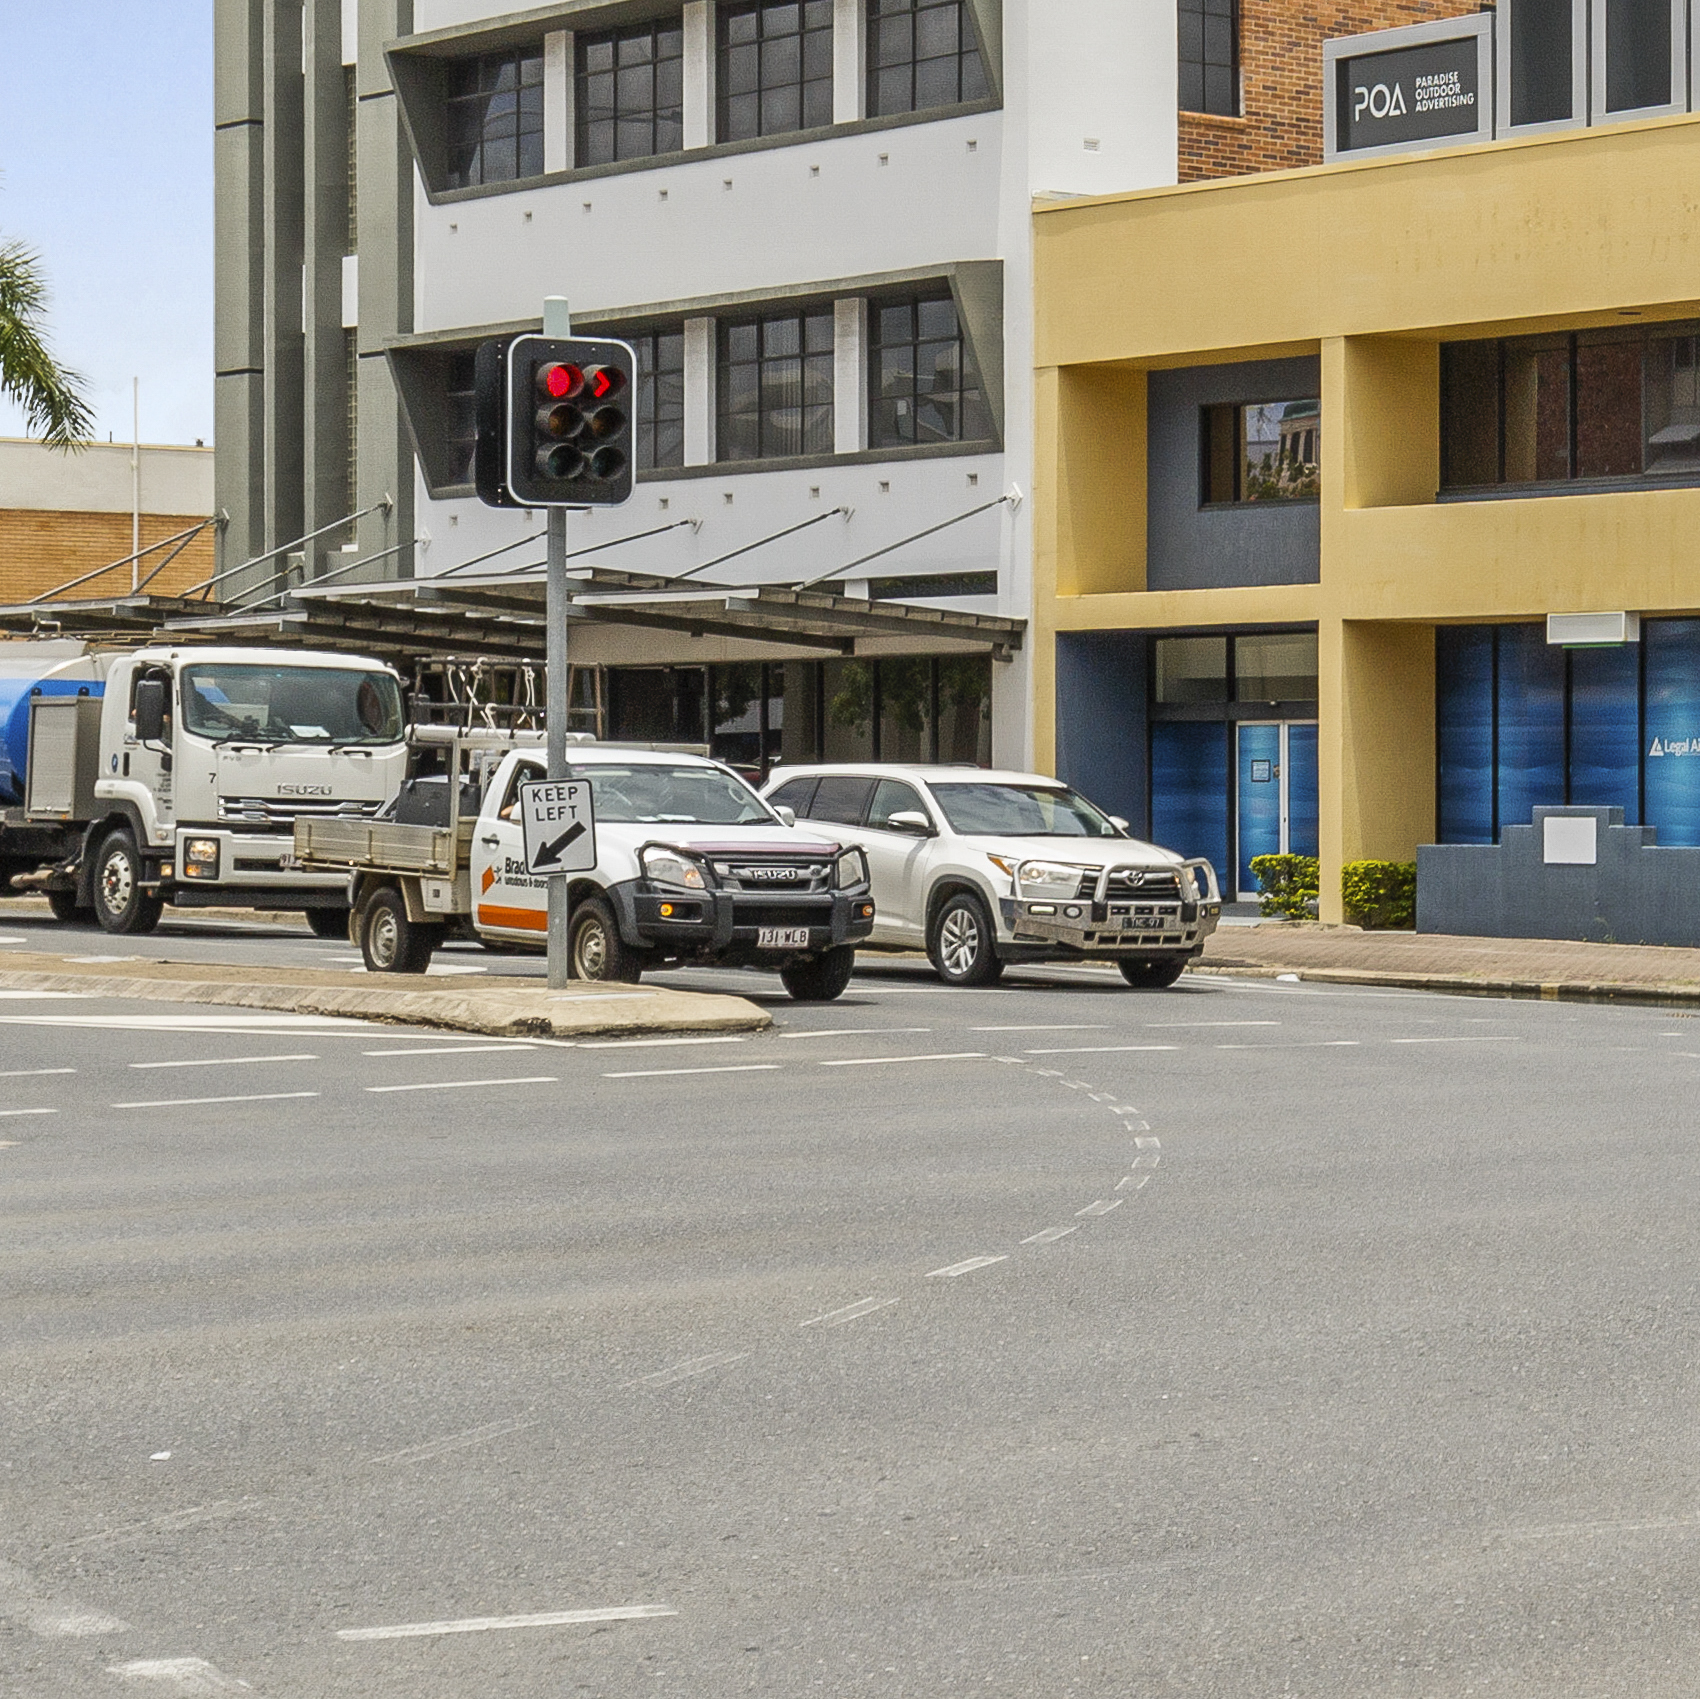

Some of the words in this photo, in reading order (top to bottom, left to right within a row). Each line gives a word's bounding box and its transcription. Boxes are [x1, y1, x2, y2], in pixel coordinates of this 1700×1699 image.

[1415, 71, 1458, 88] PARADISE
[1415, 82, 1461, 100] OUTDOOR
[1355, 82, 1407, 122] POA
[1415, 92, 1474, 112] ADVERTISING
[1664, 737, 1689, 756] Legal
[208, 772, 217, 783] 7
[277, 784, 332, 796] ISUZU
[532, 786, 578, 802] KEEP
[535, 805, 577, 821] LEFT
[754, 869, 797, 880] ISUZU
